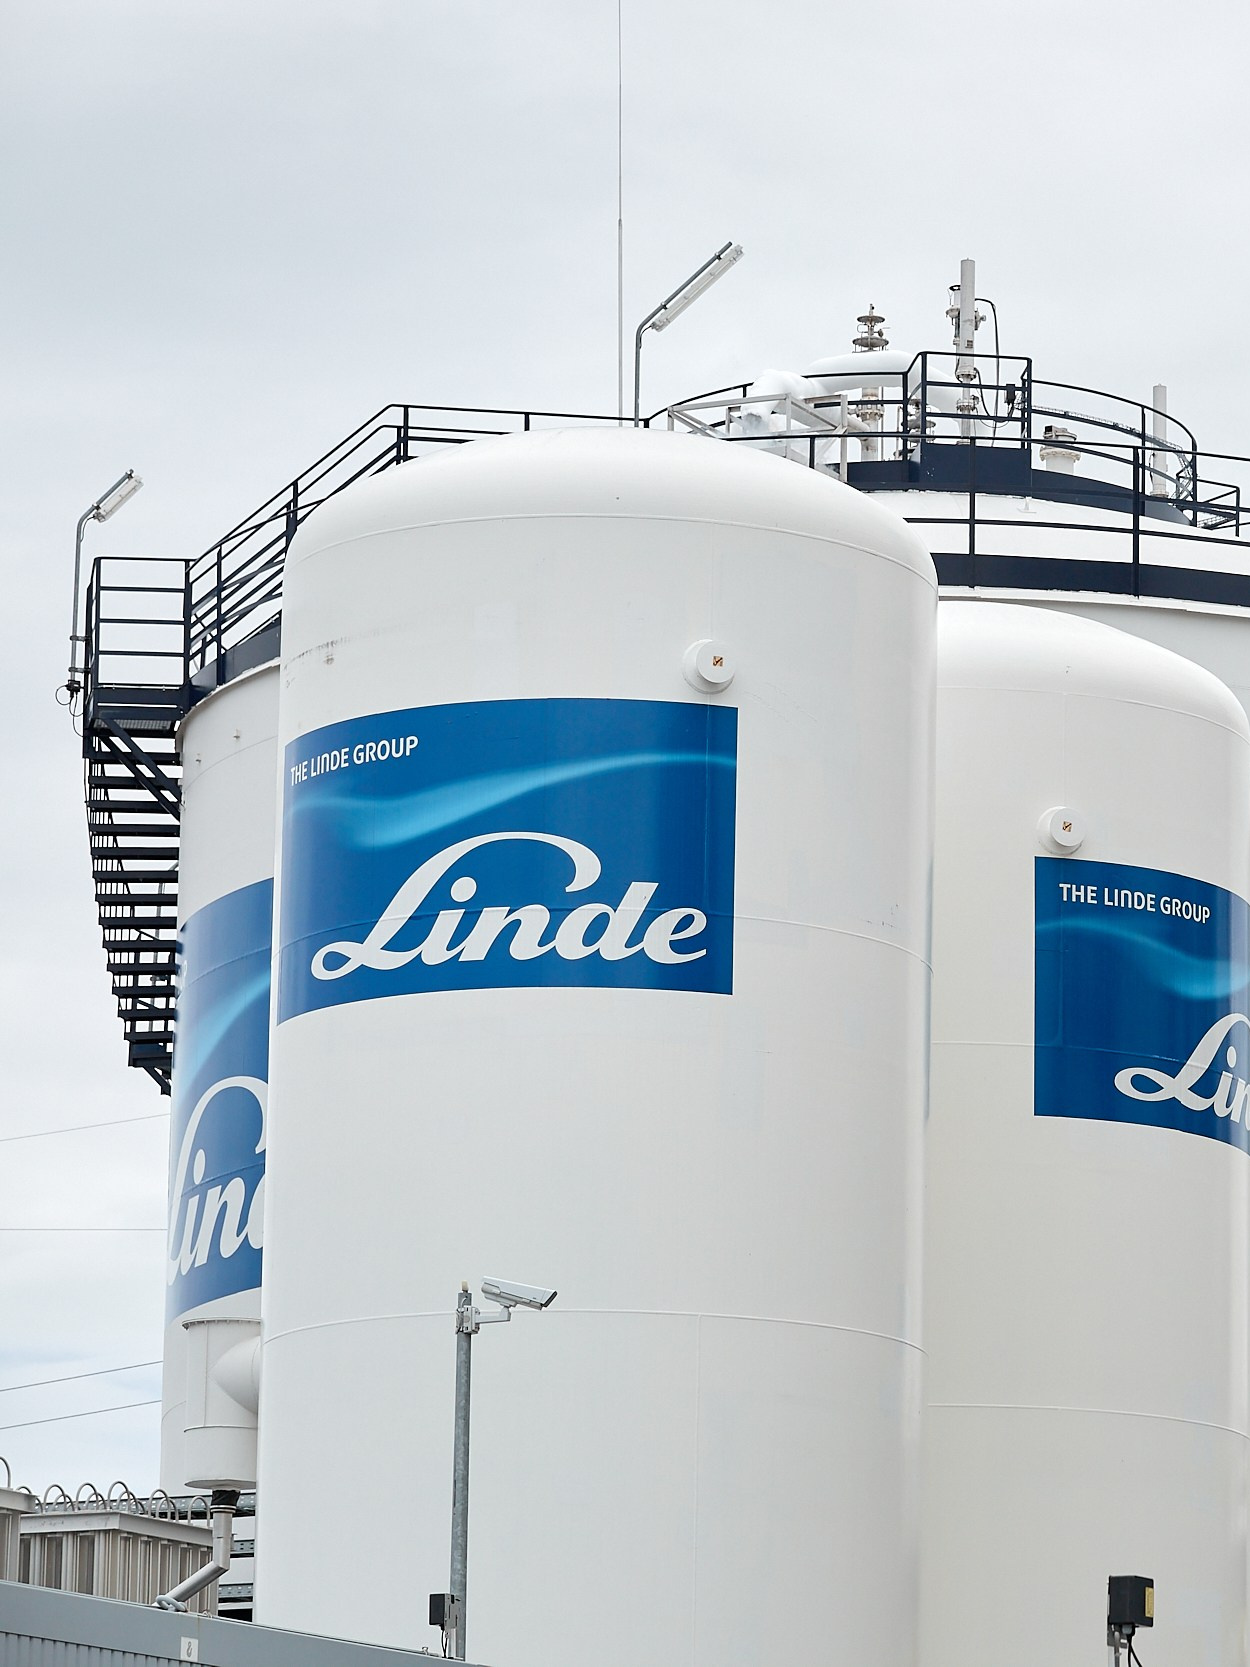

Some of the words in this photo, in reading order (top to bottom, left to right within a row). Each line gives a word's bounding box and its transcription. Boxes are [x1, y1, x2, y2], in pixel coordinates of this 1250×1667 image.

[291, 761, 308, 786] THE
[311, 748, 349, 777] LINDE
[353, 736, 418, 764] GROUP
[311, 831, 707, 980] Linde
[1059, 883, 1098, 904] THE
[1104, 888, 1156, 912] LINDE
[1160, 896, 1210, 924] GROUP
